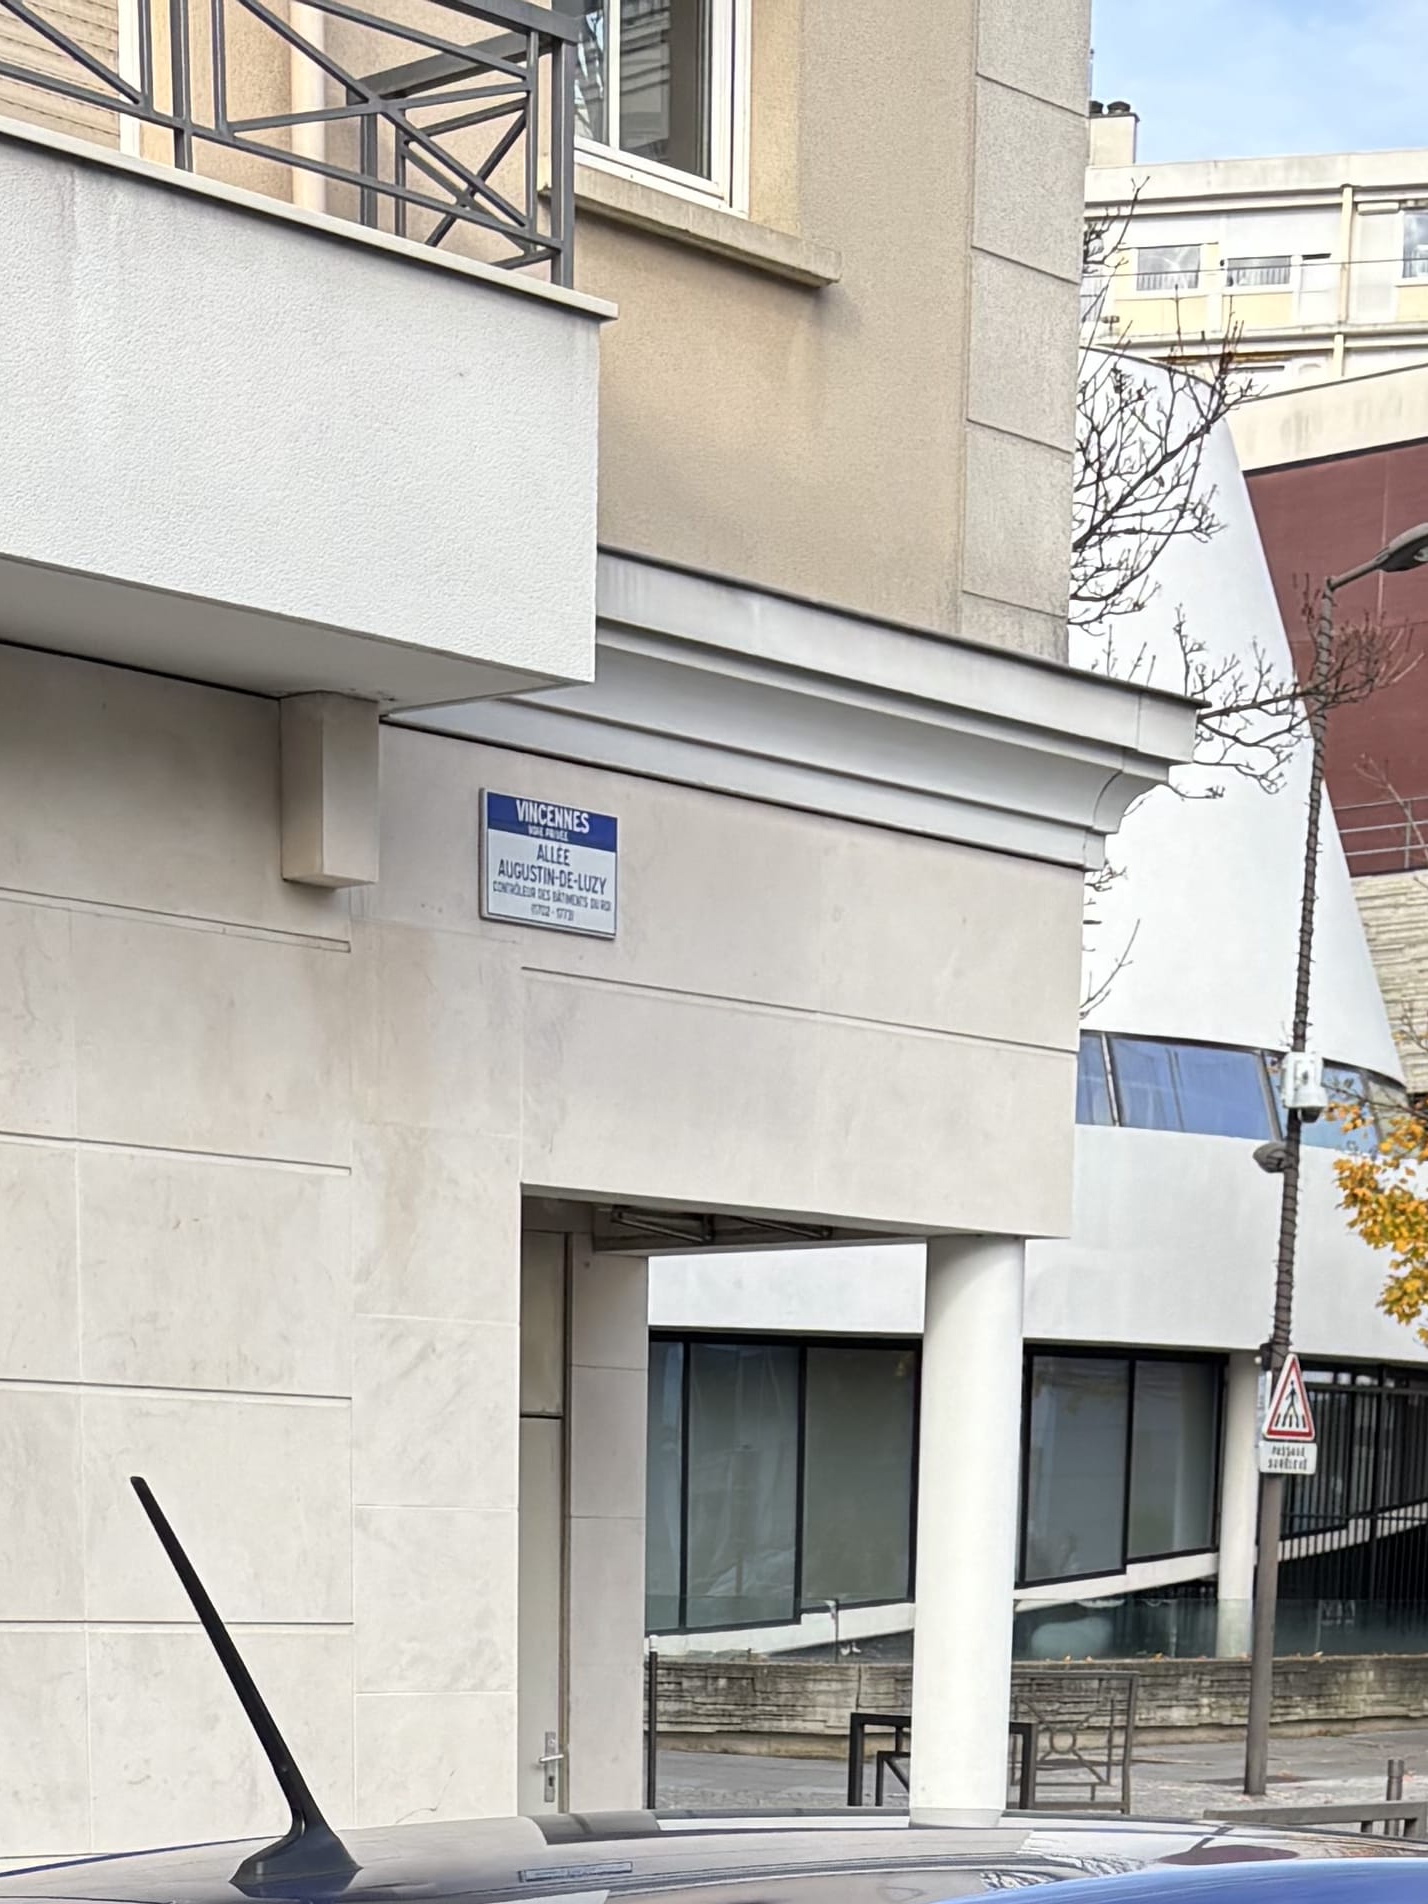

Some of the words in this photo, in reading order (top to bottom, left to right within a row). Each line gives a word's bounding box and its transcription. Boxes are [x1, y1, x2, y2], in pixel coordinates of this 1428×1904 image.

[516, 799, 590, 834] VINCENNES
[536, 842, 570, 867] ALLÉE
[498, 859, 607, 896] AUGUSTIN-DE-LUZY
